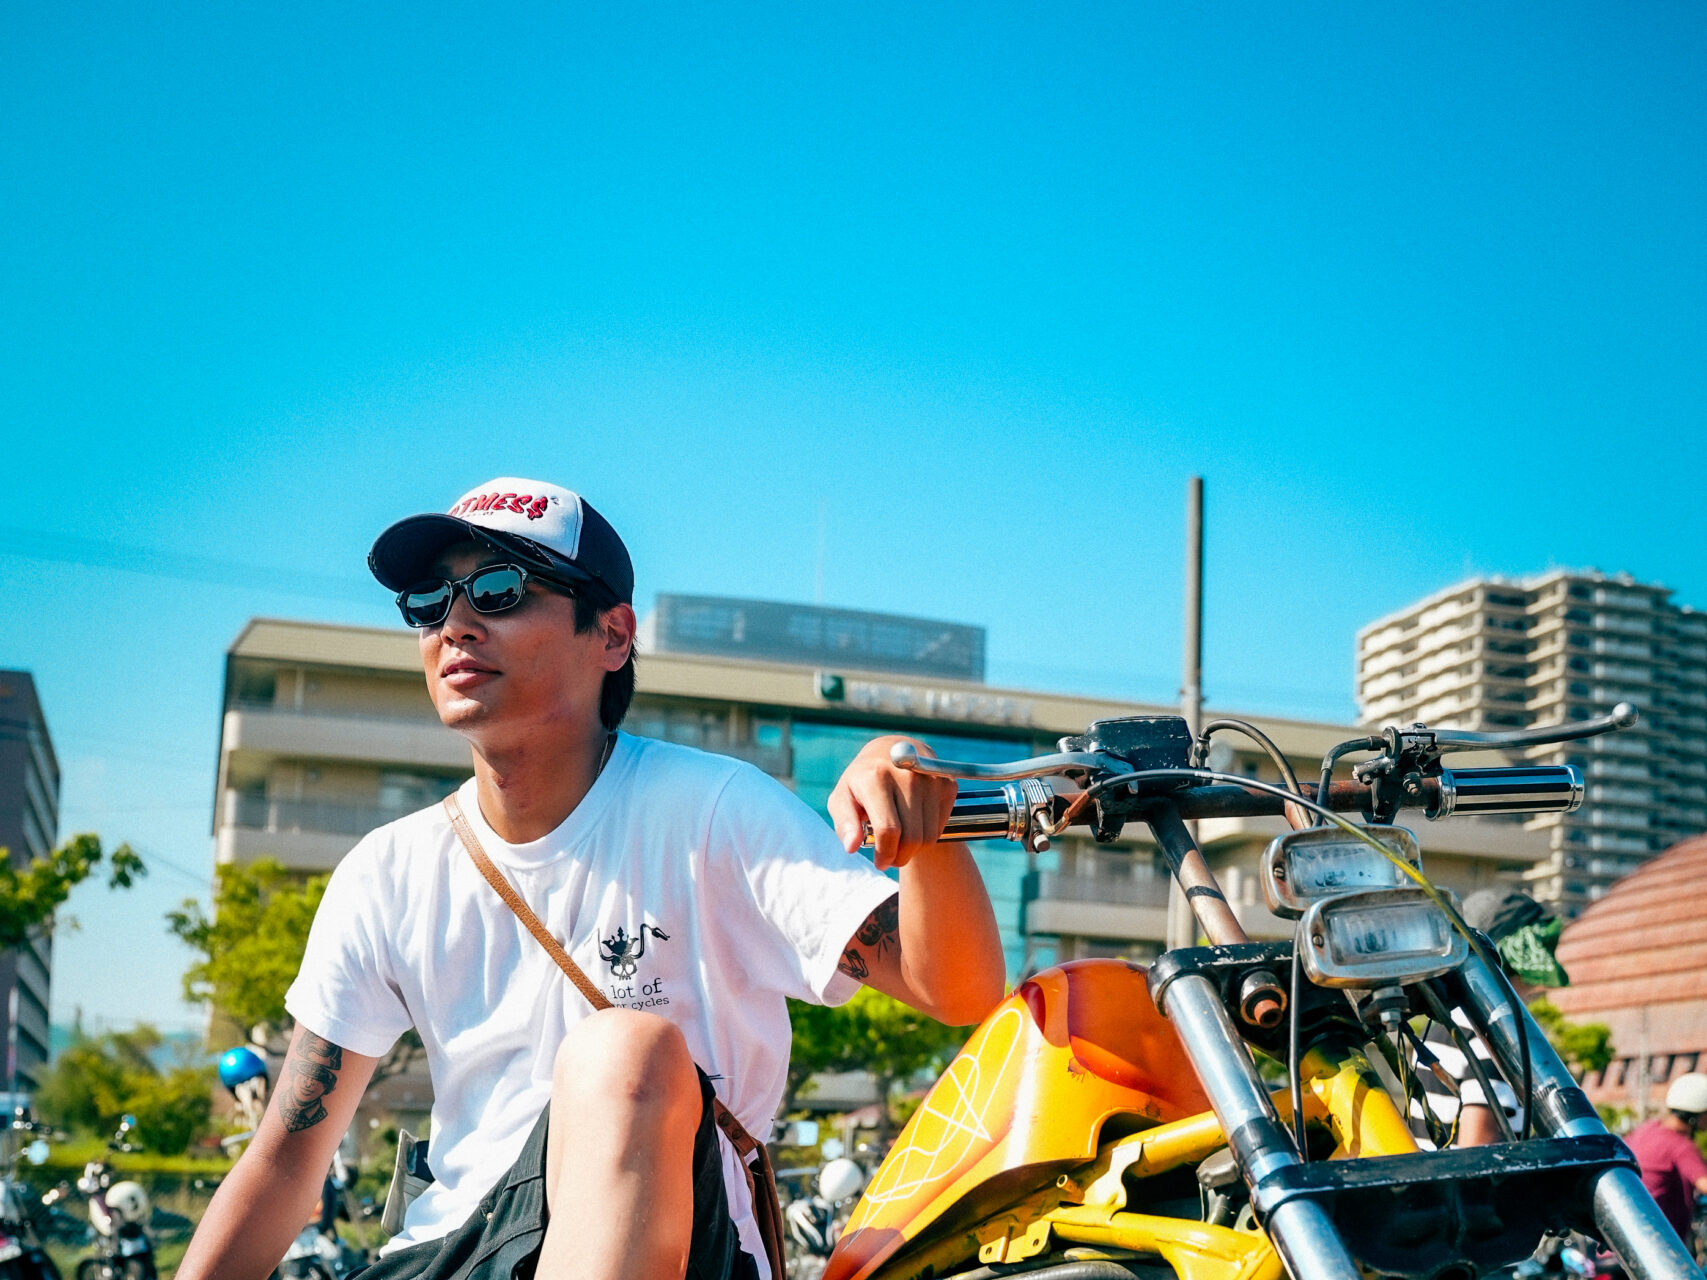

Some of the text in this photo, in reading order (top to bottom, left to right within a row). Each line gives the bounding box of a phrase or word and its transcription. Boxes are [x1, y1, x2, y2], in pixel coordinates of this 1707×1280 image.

[610, 985, 636, 999] lot
[642, 978, 662, 995] of
[632, 997, 670, 1011] cycles
